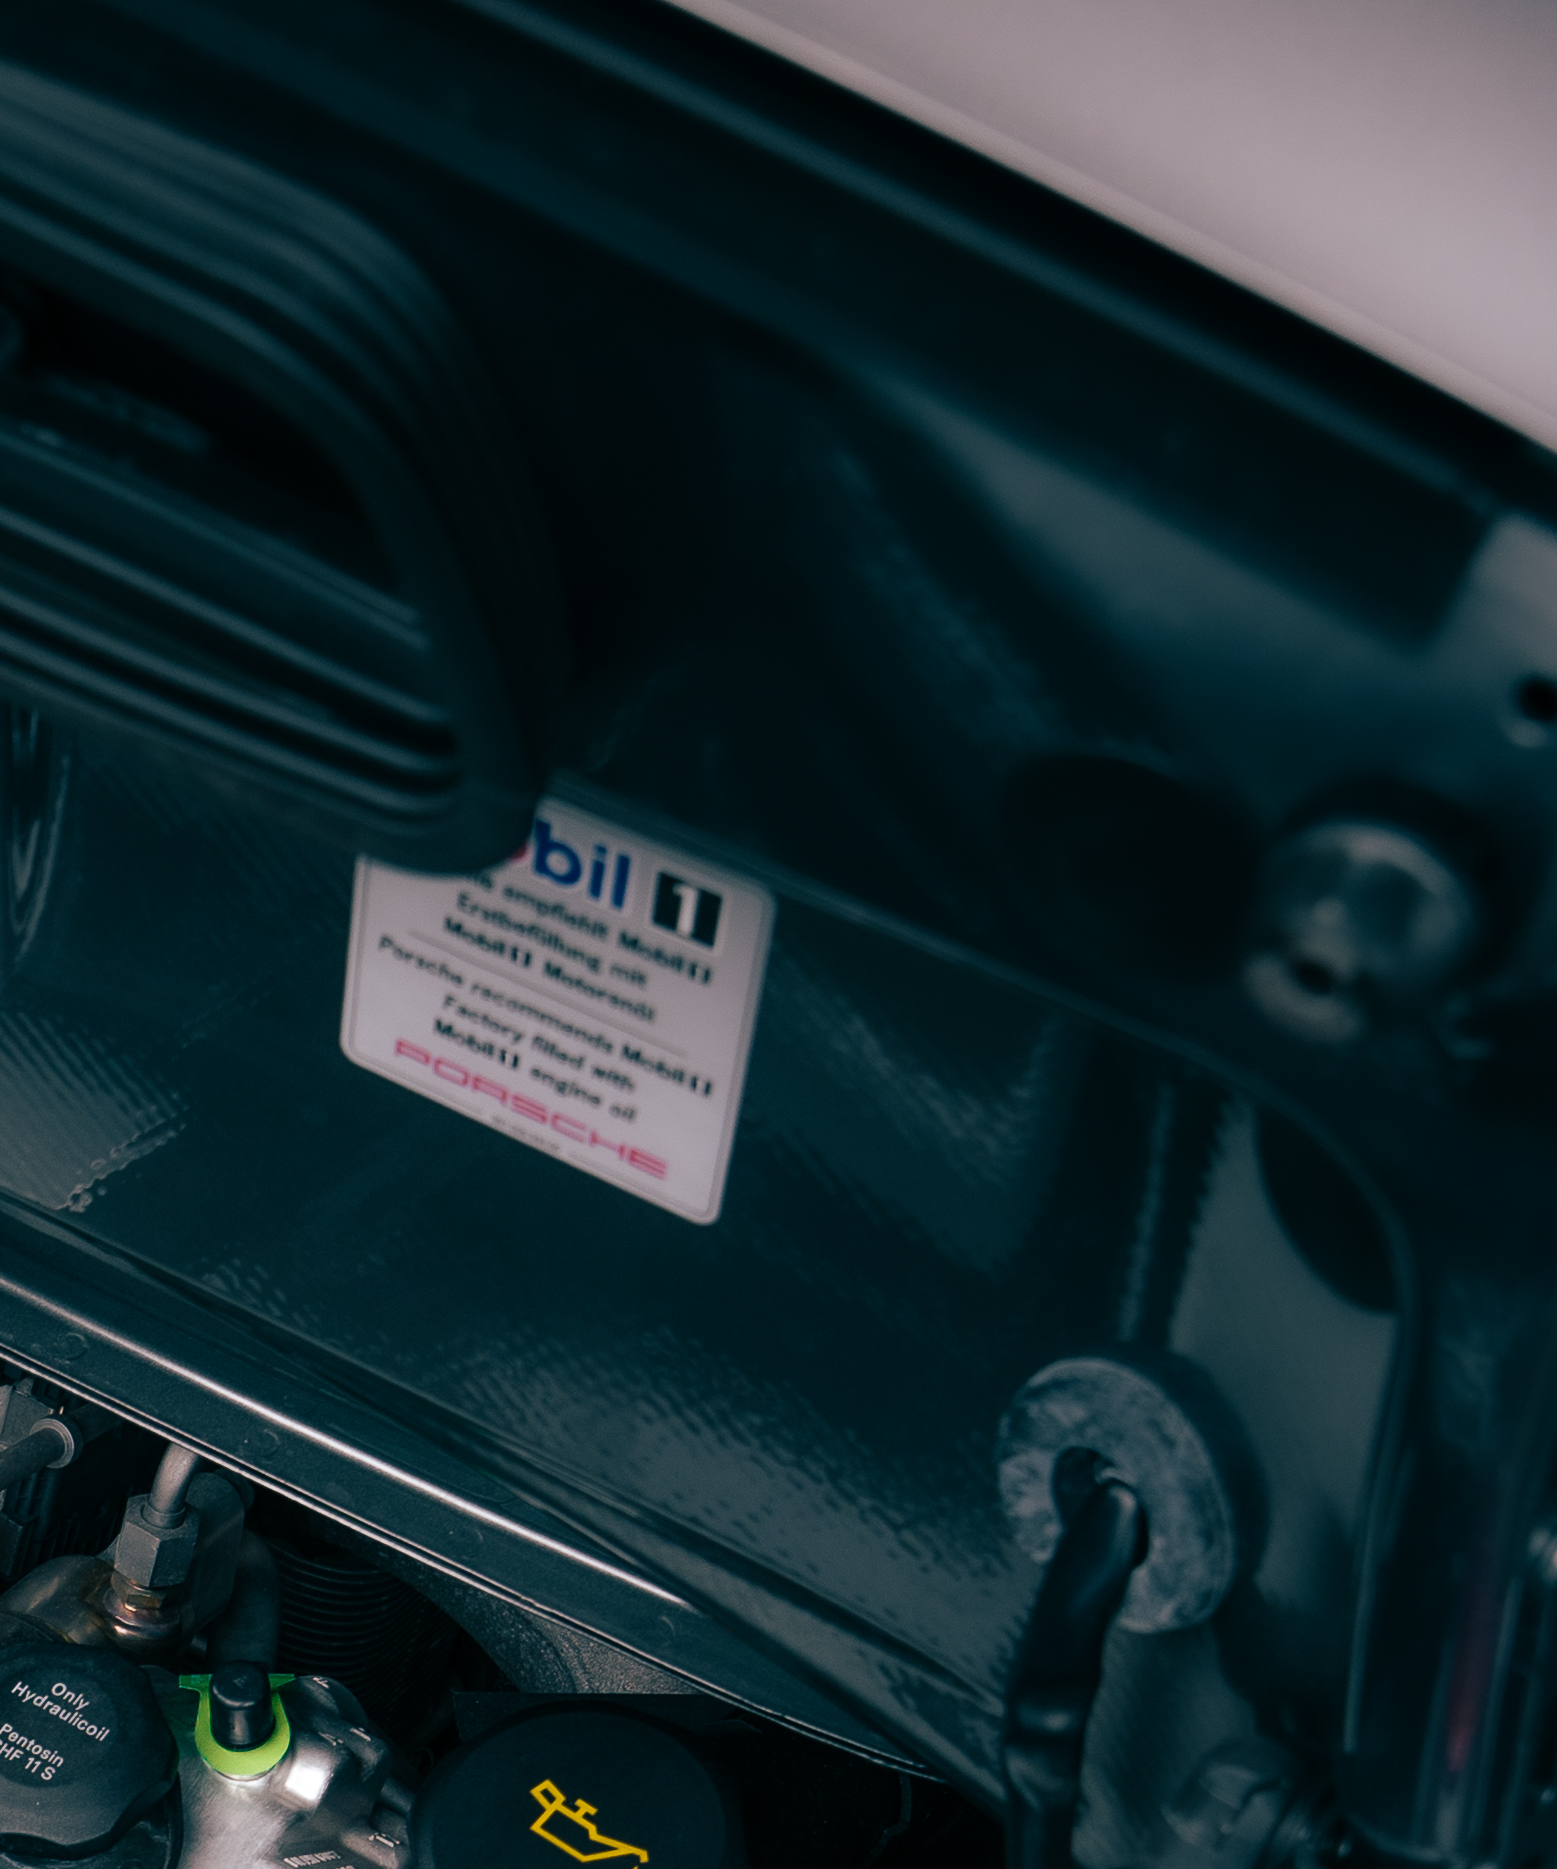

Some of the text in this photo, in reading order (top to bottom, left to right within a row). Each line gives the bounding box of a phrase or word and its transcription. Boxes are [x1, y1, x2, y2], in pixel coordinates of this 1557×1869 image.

[532, 817, 631, 910] bil
[378, 934, 465, 989] Porsche
[441, 993, 523, 1045] Factory
[592, 1059, 636, 1093] with
[394, 1037, 669, 1181] PORSCHE
[11, 1681, 111, 1742] Hydraulicoil
[50, 1682, 91, 1711] Only
[24, 1756, 41, 1774] 11
[41, 1766, 57, 1782] S
